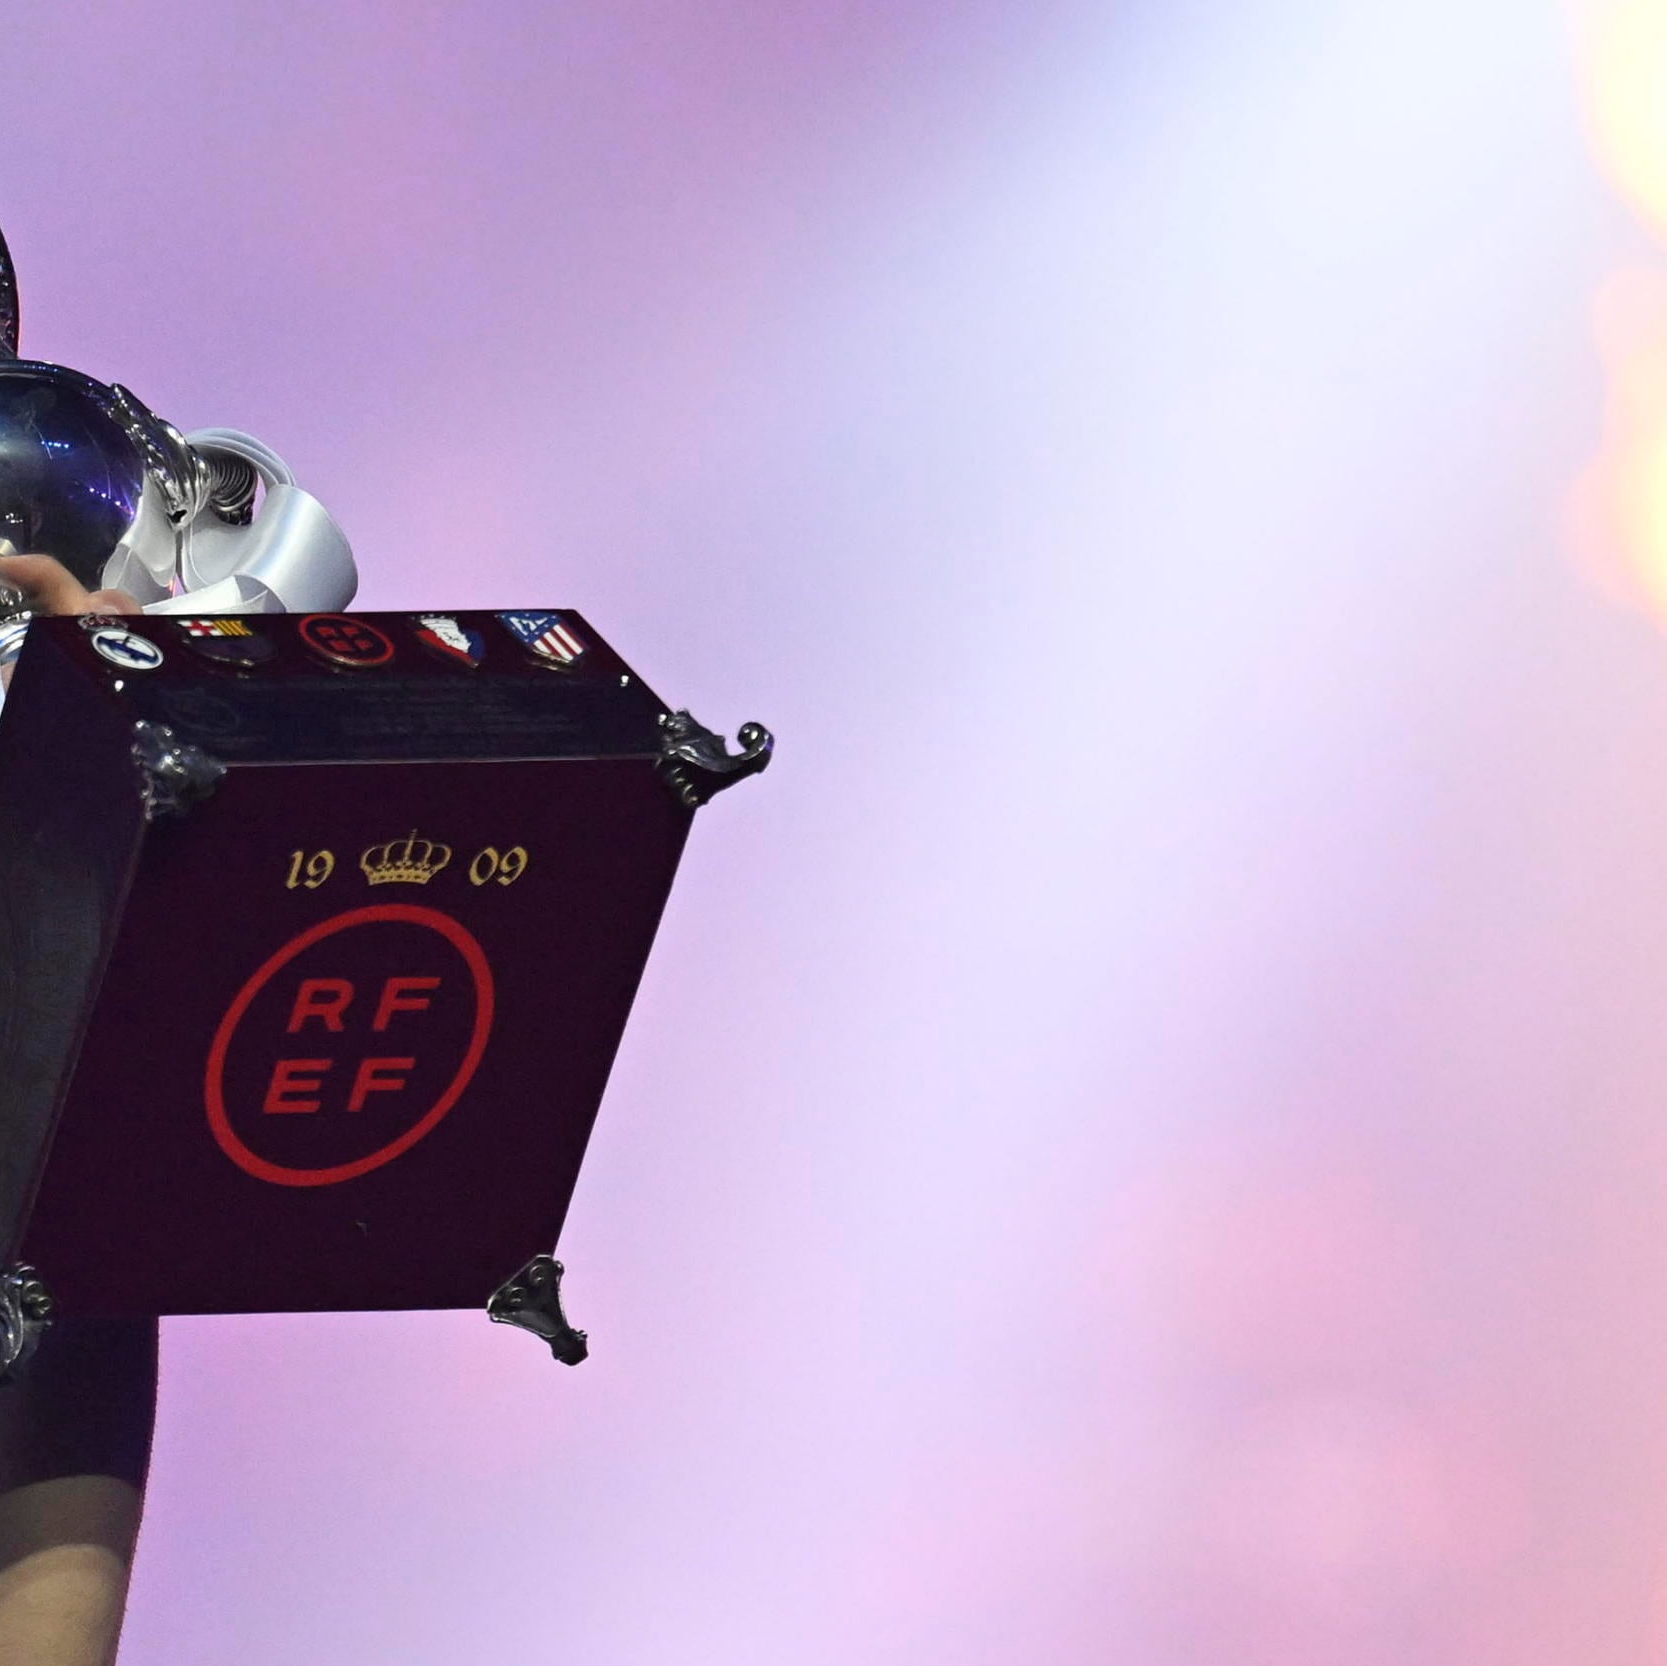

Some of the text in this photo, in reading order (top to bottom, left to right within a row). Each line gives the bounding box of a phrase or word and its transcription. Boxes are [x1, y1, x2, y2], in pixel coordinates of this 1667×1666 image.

[285, 846, 528, 889] 19 09
[286, 977, 441, 1033] RF
[262, 1057, 416, 1114] EF
